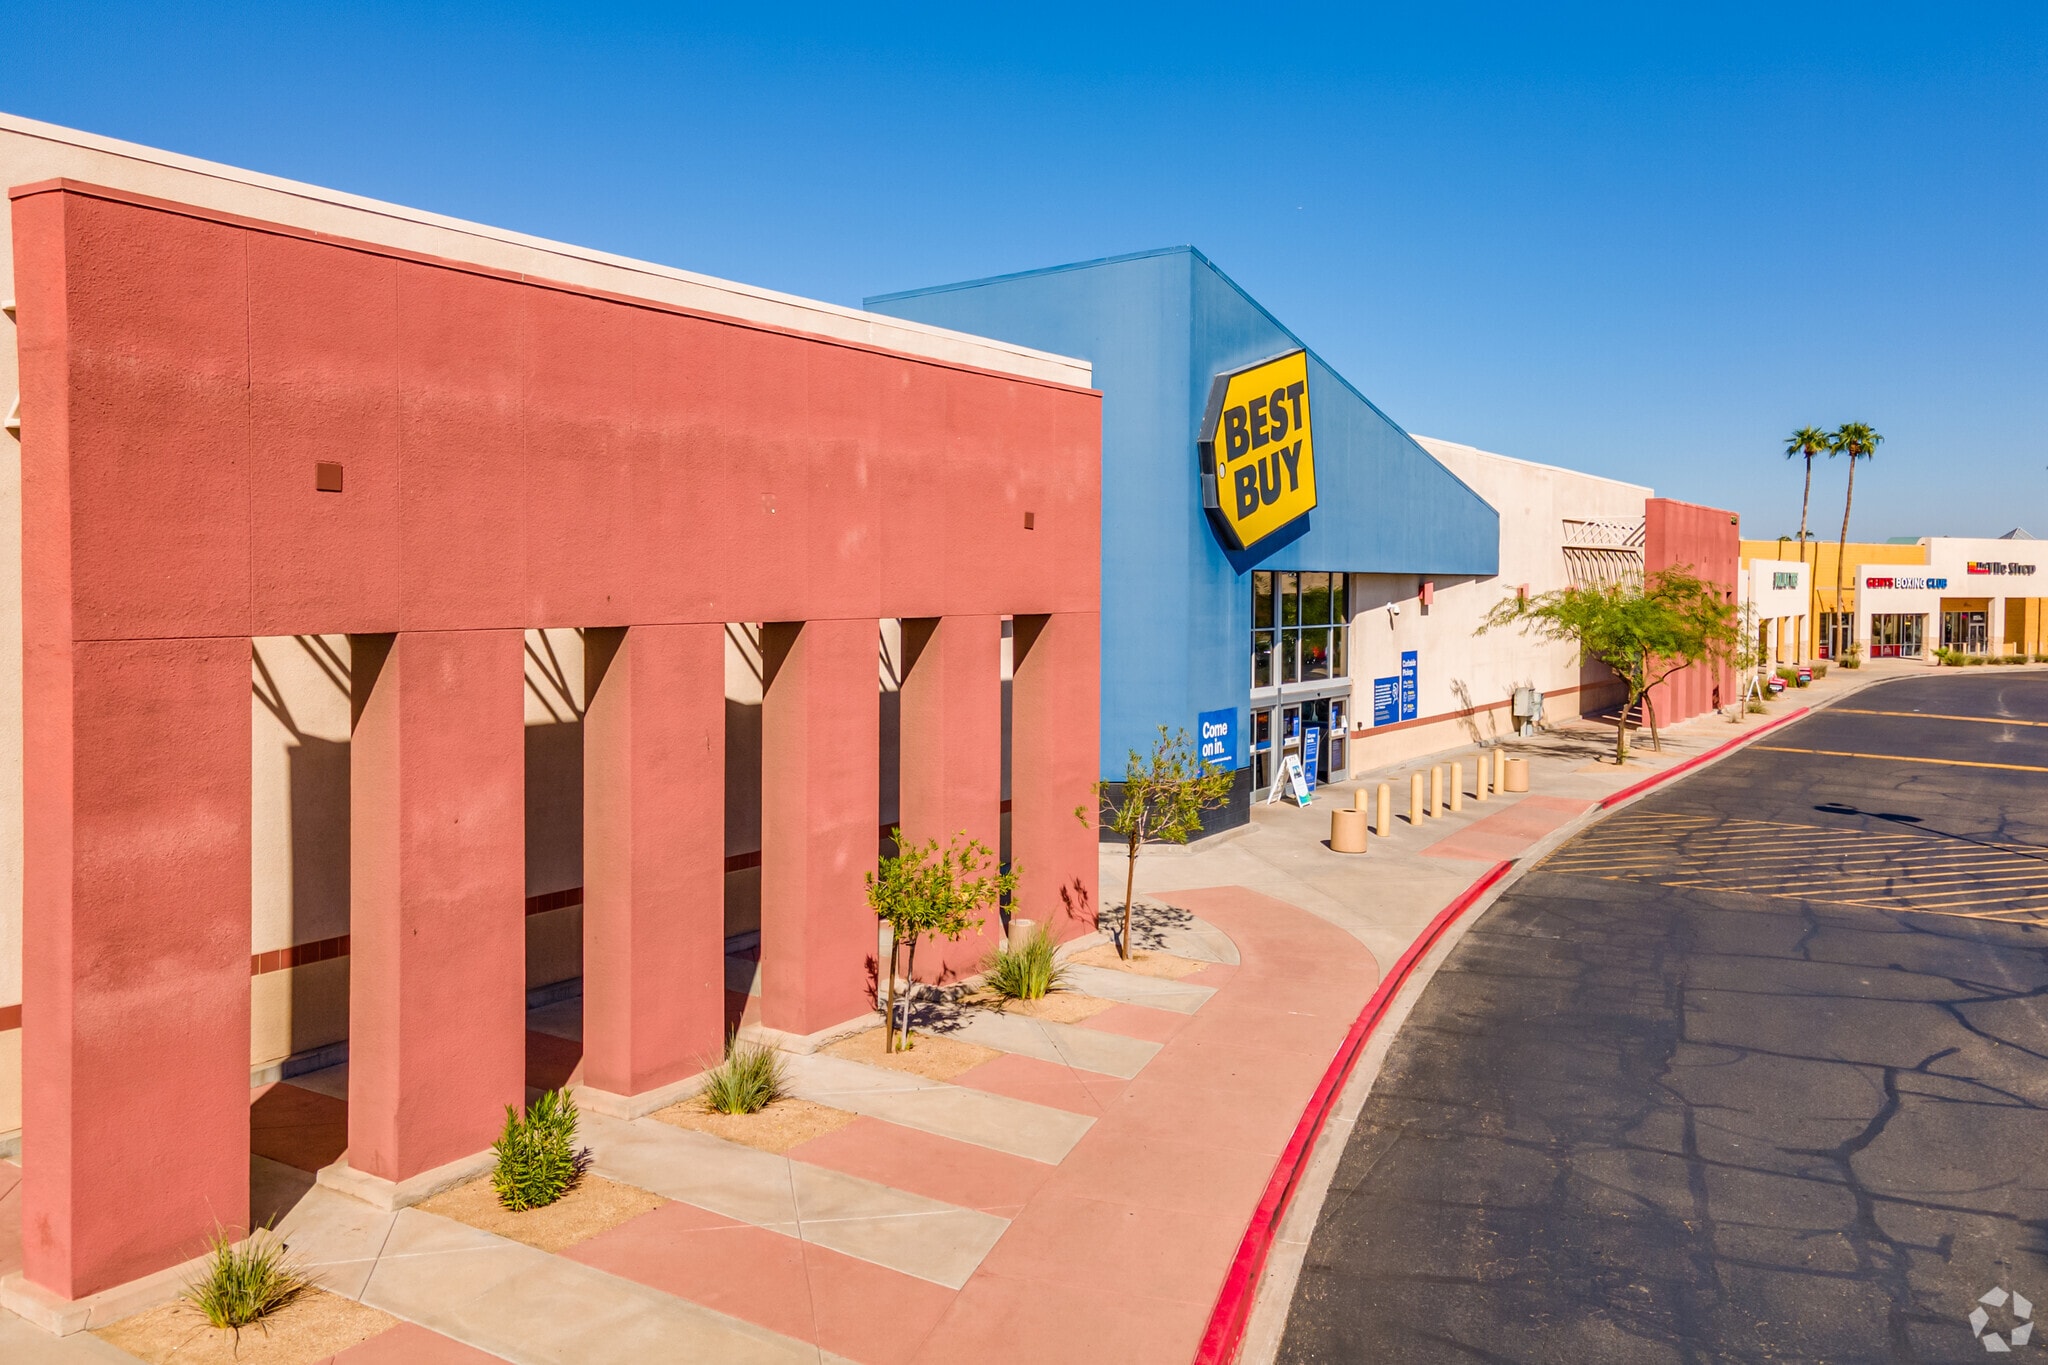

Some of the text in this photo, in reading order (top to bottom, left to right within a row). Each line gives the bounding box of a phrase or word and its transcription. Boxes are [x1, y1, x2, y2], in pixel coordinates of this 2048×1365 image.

[1224, 380, 1304, 462] BEST
[1234, 439, 1303, 521] BUY
[1895, 577, 1924, 589] BOXING
[1926, 578, 1947, 589] CLUB
[1203, 722, 1228, 739] Come
[1202, 738, 1224, 757] on in.
